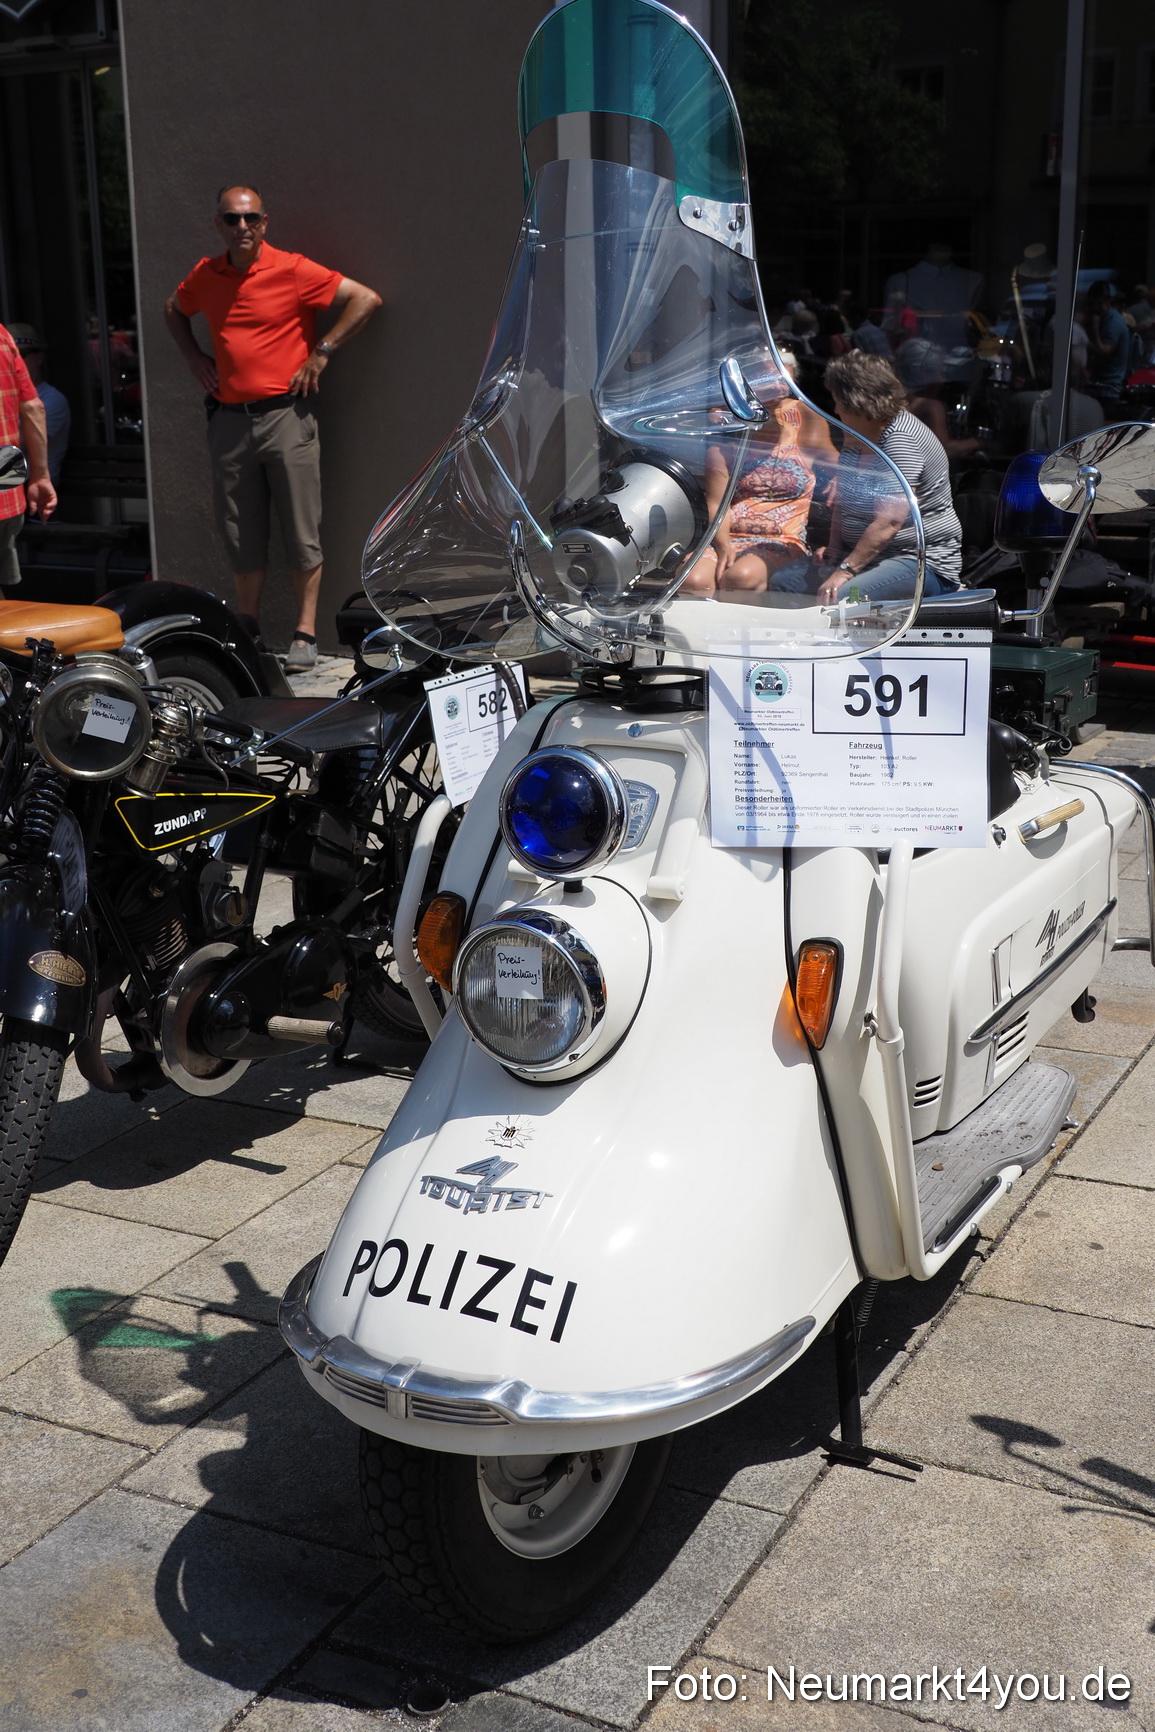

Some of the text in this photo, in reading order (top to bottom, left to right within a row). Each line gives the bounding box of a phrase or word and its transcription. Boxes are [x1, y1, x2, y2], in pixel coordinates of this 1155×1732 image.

[478, 687, 508, 718] 582
[844, 674, 929, 718] 591
[95, 698, 115, 710] Preis-
[733, 740, 775, 748] Teilnehmer
[849, 741, 883, 750] Fahrzeug
[734, 795, 794, 803] Besonderheiten
[497, 952, 526, 965] Preis-
[420, 1175, 555, 1215] TOURIST
[342, 1238, 578, 1344] POLIZEI
